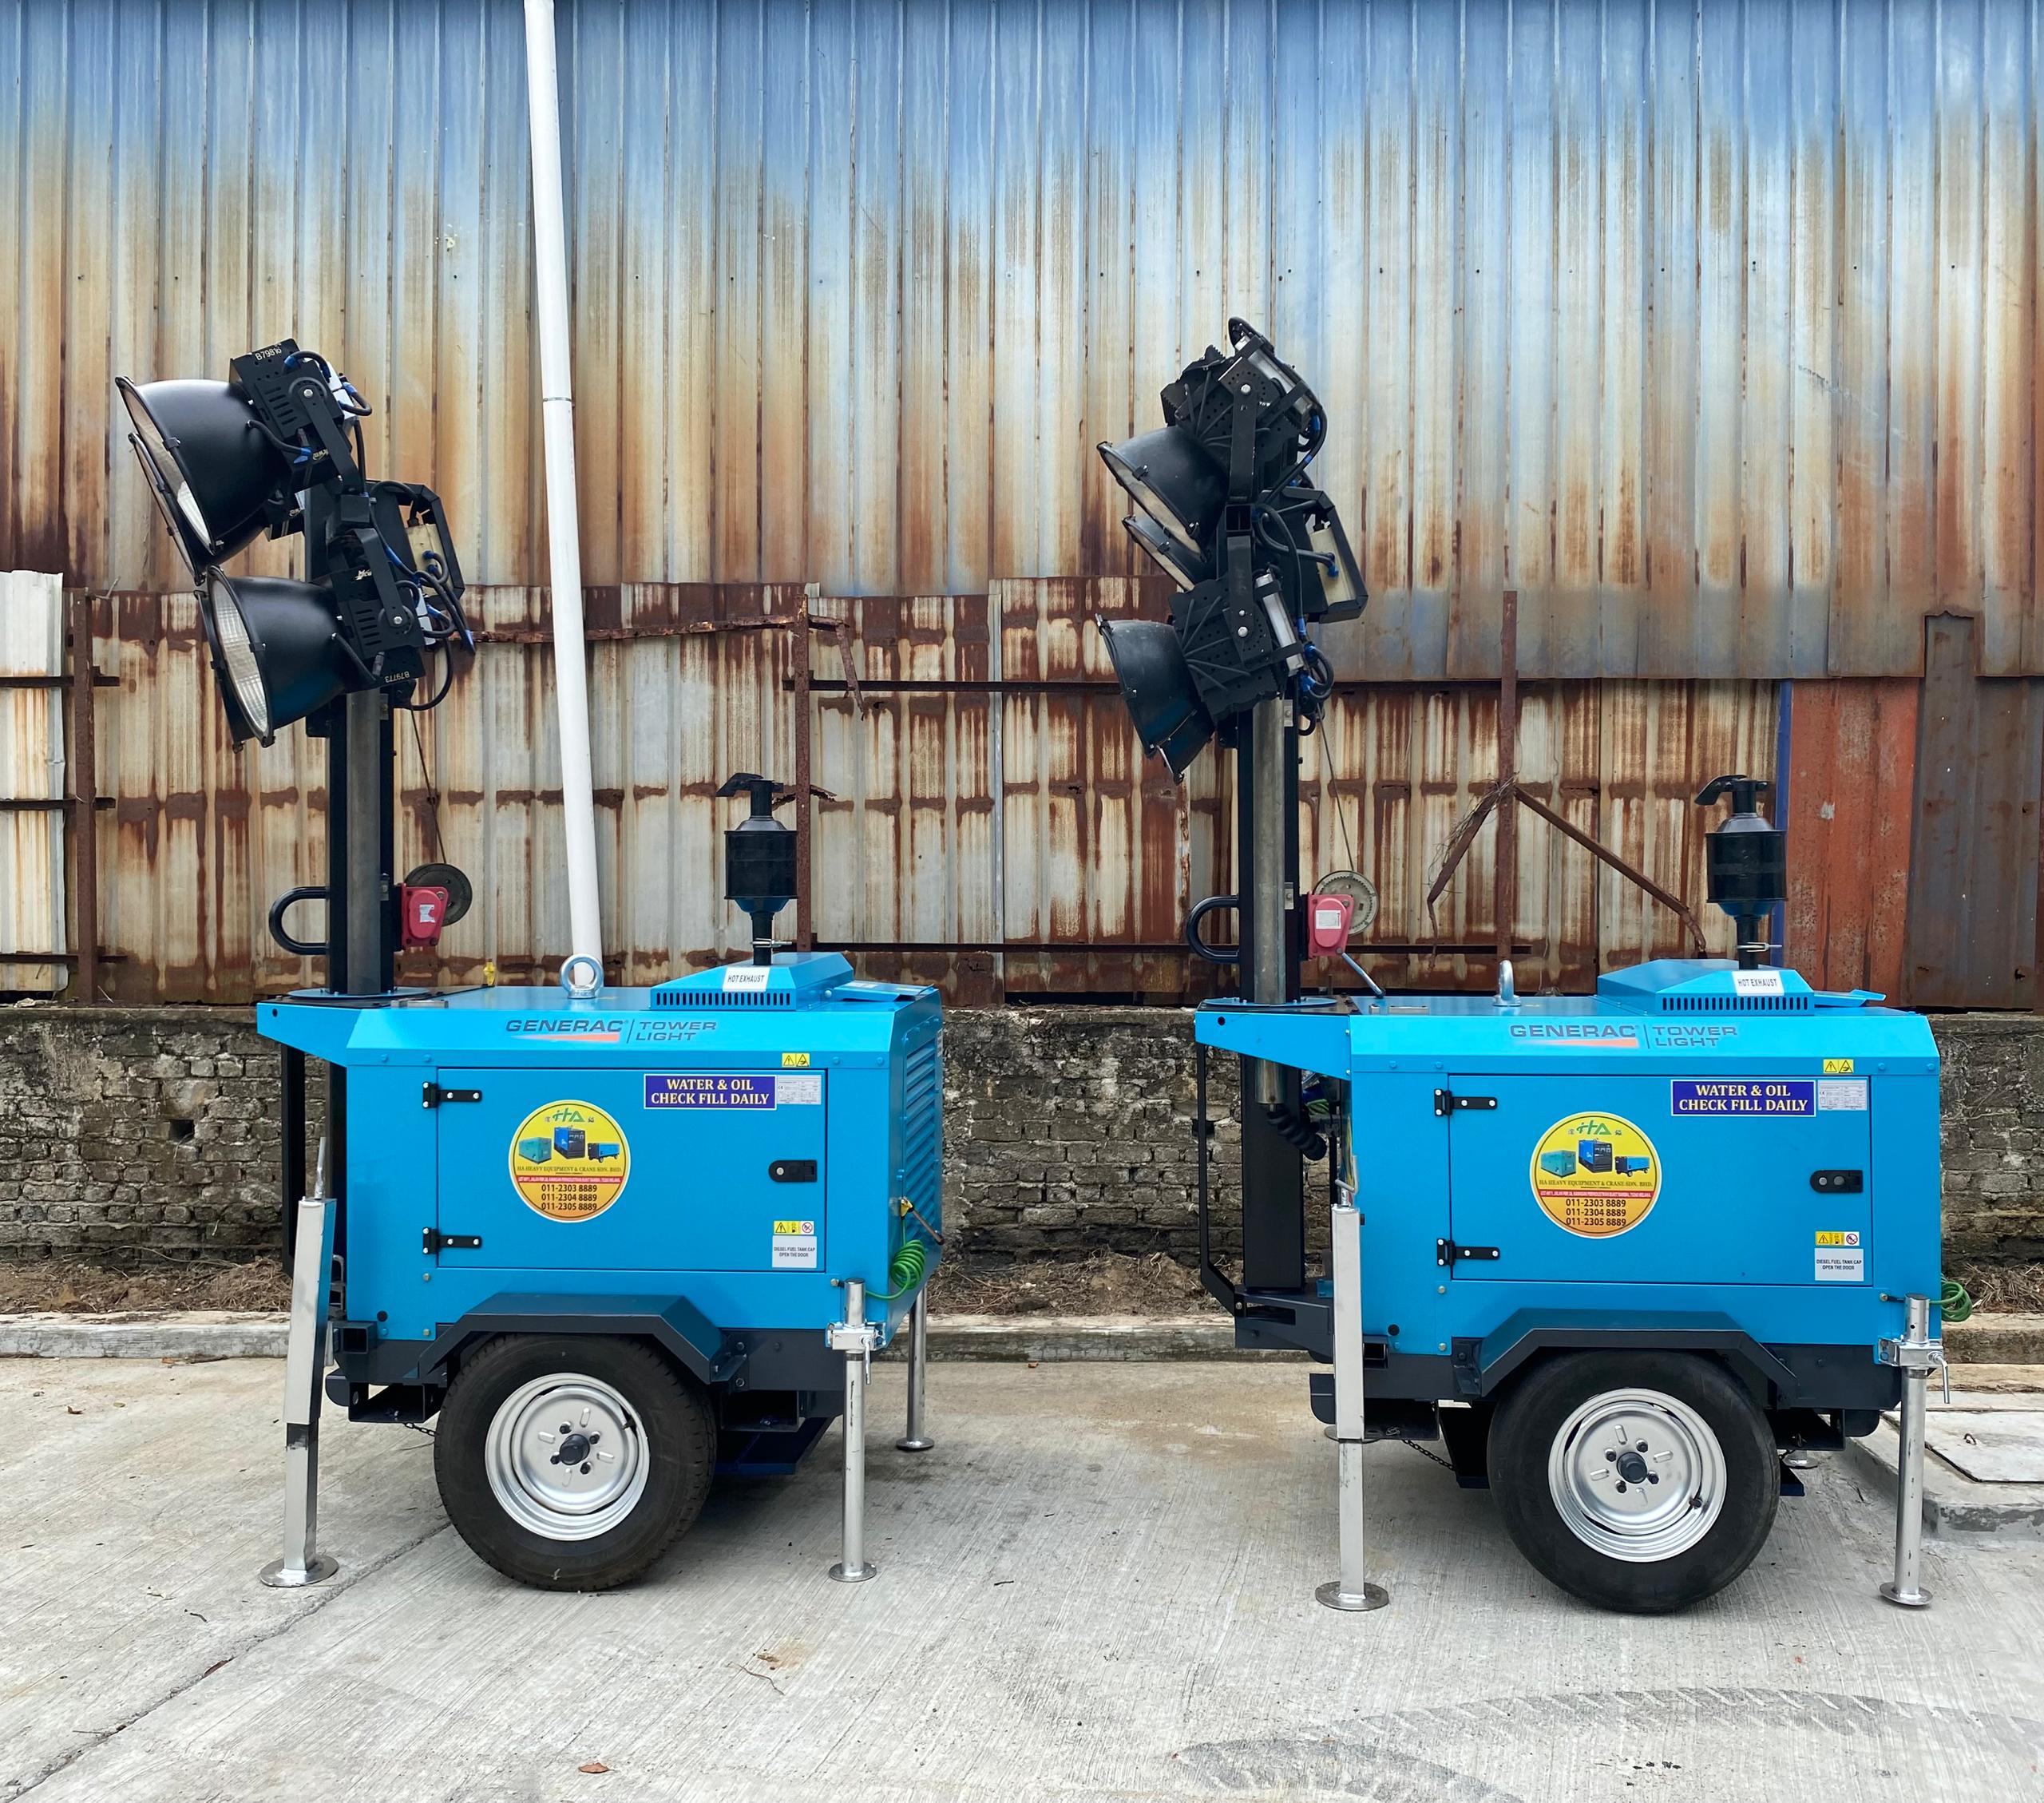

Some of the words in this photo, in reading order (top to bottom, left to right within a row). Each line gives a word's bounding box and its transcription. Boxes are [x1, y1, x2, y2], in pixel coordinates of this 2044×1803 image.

[727, 974, 739, 983] HOT
[739, 974, 765, 983] EXHAUST
[505, 1020, 624, 1032] GENERAC
[639, 1021, 717, 1030] TOWER
[1510, 1024, 1636, 1037] GENERAC
[1652, 1026, 1737, 1036] TOWER
[636, 1032, 697, 1041] LIGHT
[1655, 1037, 1719, 1047] LIGHT
[667, 1079, 714, 1091] WATER
[717, 1079, 727, 1091] &
[731, 1079, 754, 1091] OIL
[1695, 1084, 1747, 1096] WATER
[1750, 1084, 1762, 1096] &
[1765, 1084, 1791, 1096] OIL
[651, 1092, 695, 1104] CHECK
[699, 1092, 727, 1104] FILL
[731, 1093, 770, 1105] DAILY
[1679, 1099, 1728, 1111] CHECK
[1731, 1099, 1762, 1111] FILL
[1765, 1099, 1808, 1112] DAILY
[1566, 1217, 1604, 1226] 011-2305
[1606, 1218, 1626, 1226] 8889
